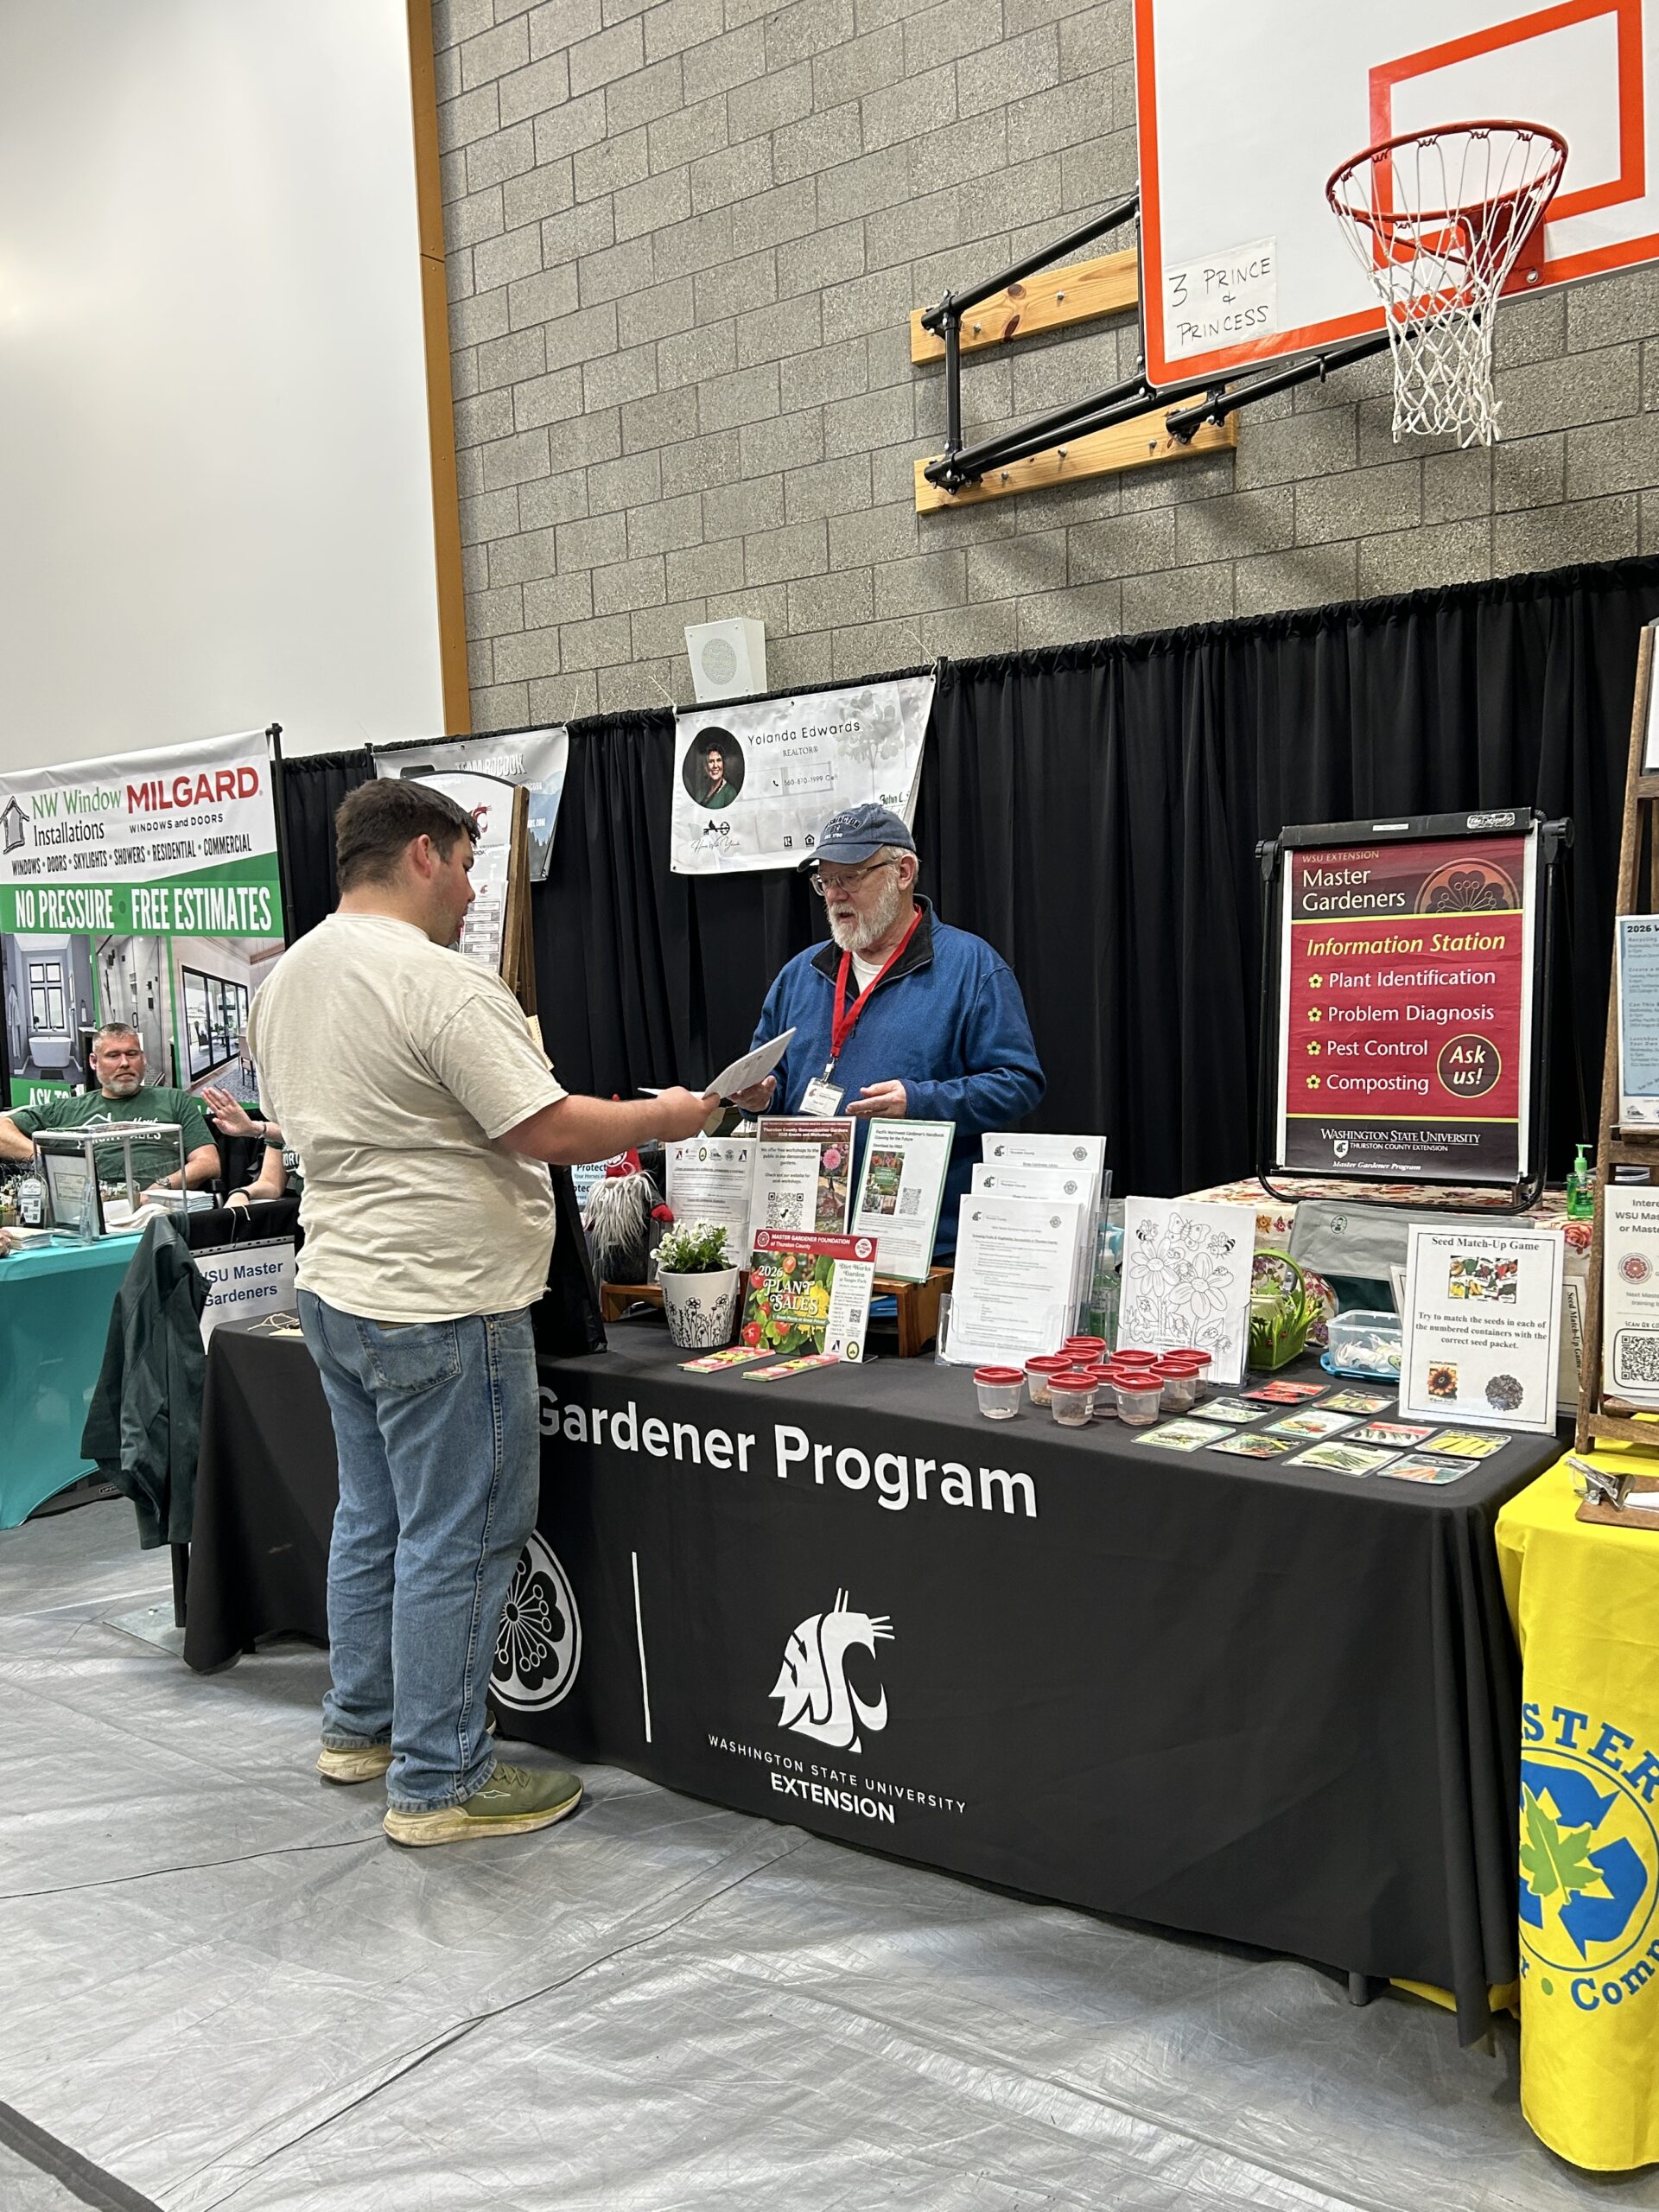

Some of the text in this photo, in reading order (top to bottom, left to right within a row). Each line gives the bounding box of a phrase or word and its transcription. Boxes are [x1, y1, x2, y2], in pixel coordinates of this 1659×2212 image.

[1169, 258, 1270, 307] 3 PRINCE
[1177, 305, 1268, 346] PRINCESS
[748, 721, 861, 746] Yolanda Edwards
[127, 767, 259, 814] MILGARD
[31, 786, 121, 819] NW Window
[34, 820, 105, 847] Installations
[130, 813, 223, 834] WINDOWS and DOORS
[11, 834, 252, 876] WINDOWS DOORS SKYLIGHTS SHOWERS RESIDENTIAL COMMERCIAL
[1302, 851, 1379, 863] WSU EXTENSION
[1303, 868, 1370, 887] Master
[15, 887, 272, 931] NO PRESSURE FREE ESTIMATES
[1303, 889, 1406, 912] Gardeners
[1306, 932, 1505, 957] Information Station
[1329, 969, 1495, 988] Plant Identification
[1328, 1004, 1495, 1025] Problem Diagnosis
[1327, 1039, 1428, 1057] Pest Control
[1449, 1046, 1485, 1065] Ask
[1326, 1074, 1428, 1095] Composting
[1452, 1068, 1482, 1085] us!
[29, 1088, 51, 1106] ASK
[1320, 1128, 1481, 1144] WASHINGTON STATE UNIVERSITY
[1432, 1236, 1540, 1250] Seed Match-Up Game
[233, 1261, 283, 1280] Master
[759, 1266, 784, 1278] 2026
[204, 1282, 277, 1306] Gardeners
[763, 1280, 815, 1296] PLANT
[770, 1294, 818, 1315] SALES
[1418, 1312, 1432, 1320] Try
[1443, 1313, 1467, 1323] match
[1537, 1320, 1546, 1329] of
[1570, 1311, 1580, 1346] Match-Up
[1429, 1325, 1469, 1334] numbered
[1471, 1328, 1512, 1338] containers
[1441, 1337, 1519, 1350] correct seed packet.
[537, 1388, 1037, 1517] Gardener Program
[708, 1733, 966, 1814] WASHINGTON STATE UNIVERSITY
[770, 1771, 895, 1824] EXTENSION
